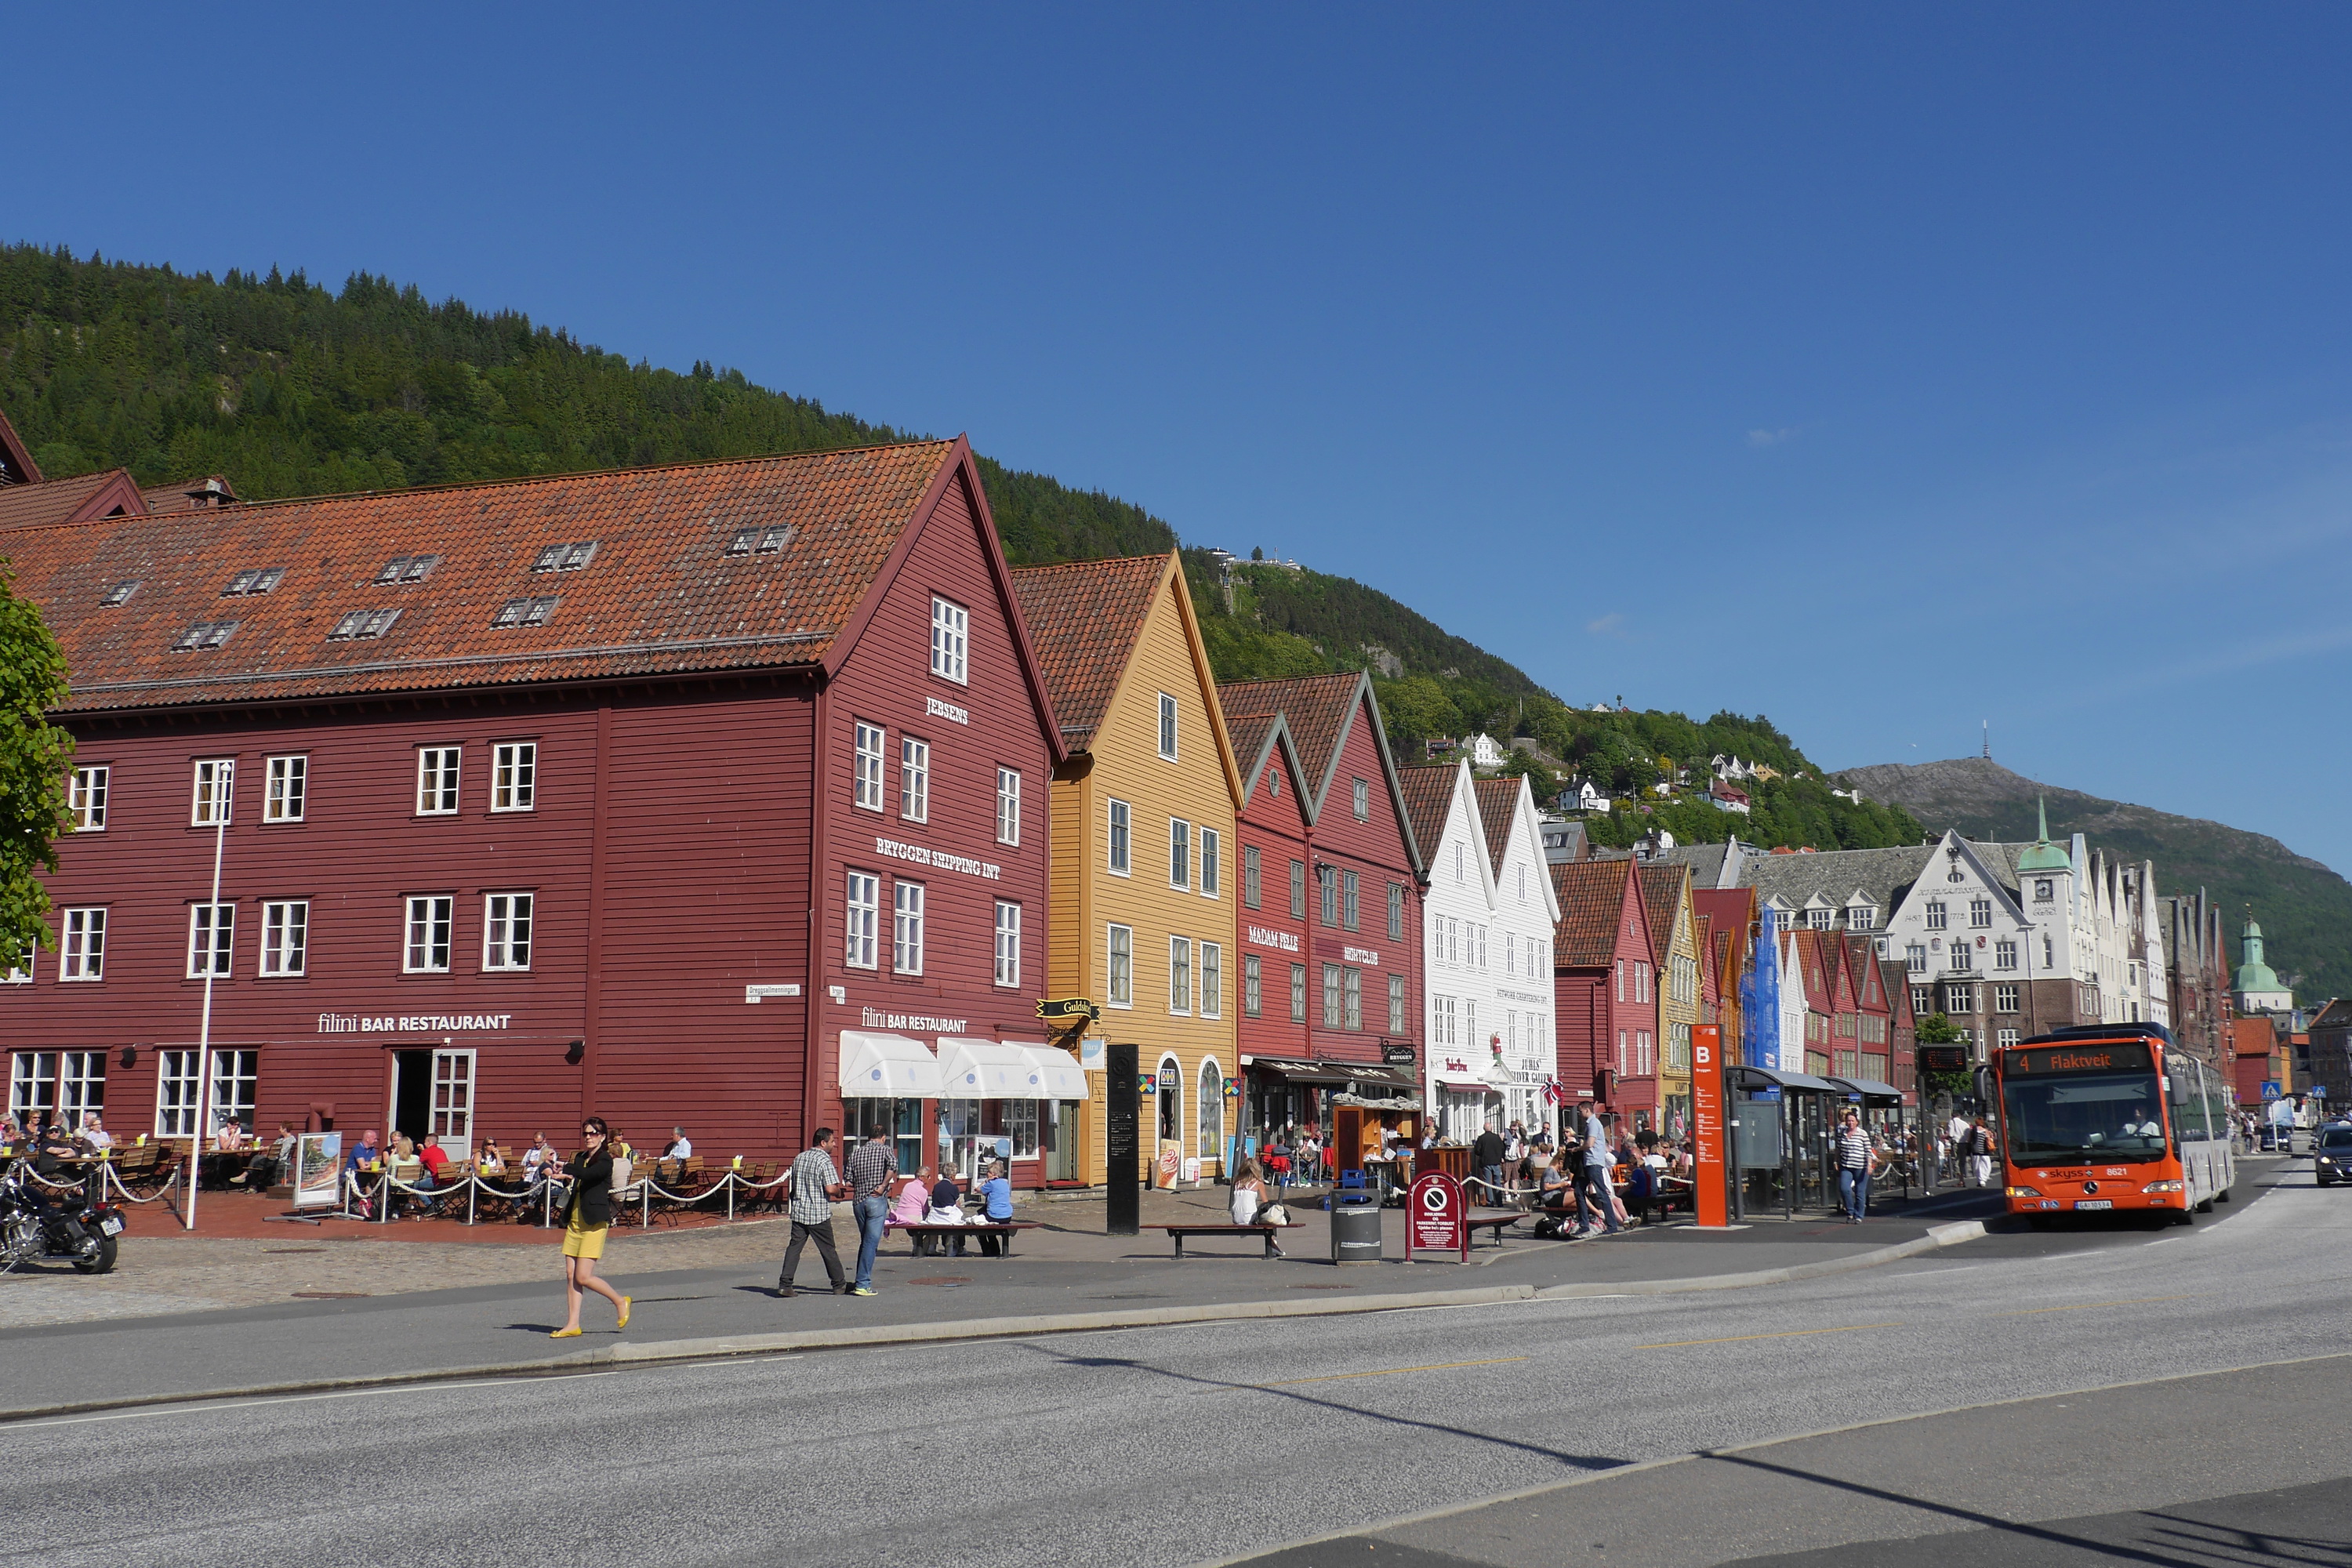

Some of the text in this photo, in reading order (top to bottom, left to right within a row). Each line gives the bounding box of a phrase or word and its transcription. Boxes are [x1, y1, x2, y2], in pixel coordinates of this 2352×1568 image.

[926, 696, 968, 725] JEBSENS
[876, 837, 1000, 880] BRYGGEN SHIPPING INT
[1249, 926, 1298, 952] MADAM FELLE
[1344, 946, 1378, 965] NIGHTCLUB
[318, 1014, 511, 1033] filini BAR RESTAURANT
[862, 1007, 967, 1033] filini BAR RESTAURANT
[1696, 1046, 1710, 1063] B
[2020, 1054, 2111, 1071] 4 Flaktveit
[2050, 1169, 2084, 1179] skyss
[2107, 1167, 2127, 1176] 8621
